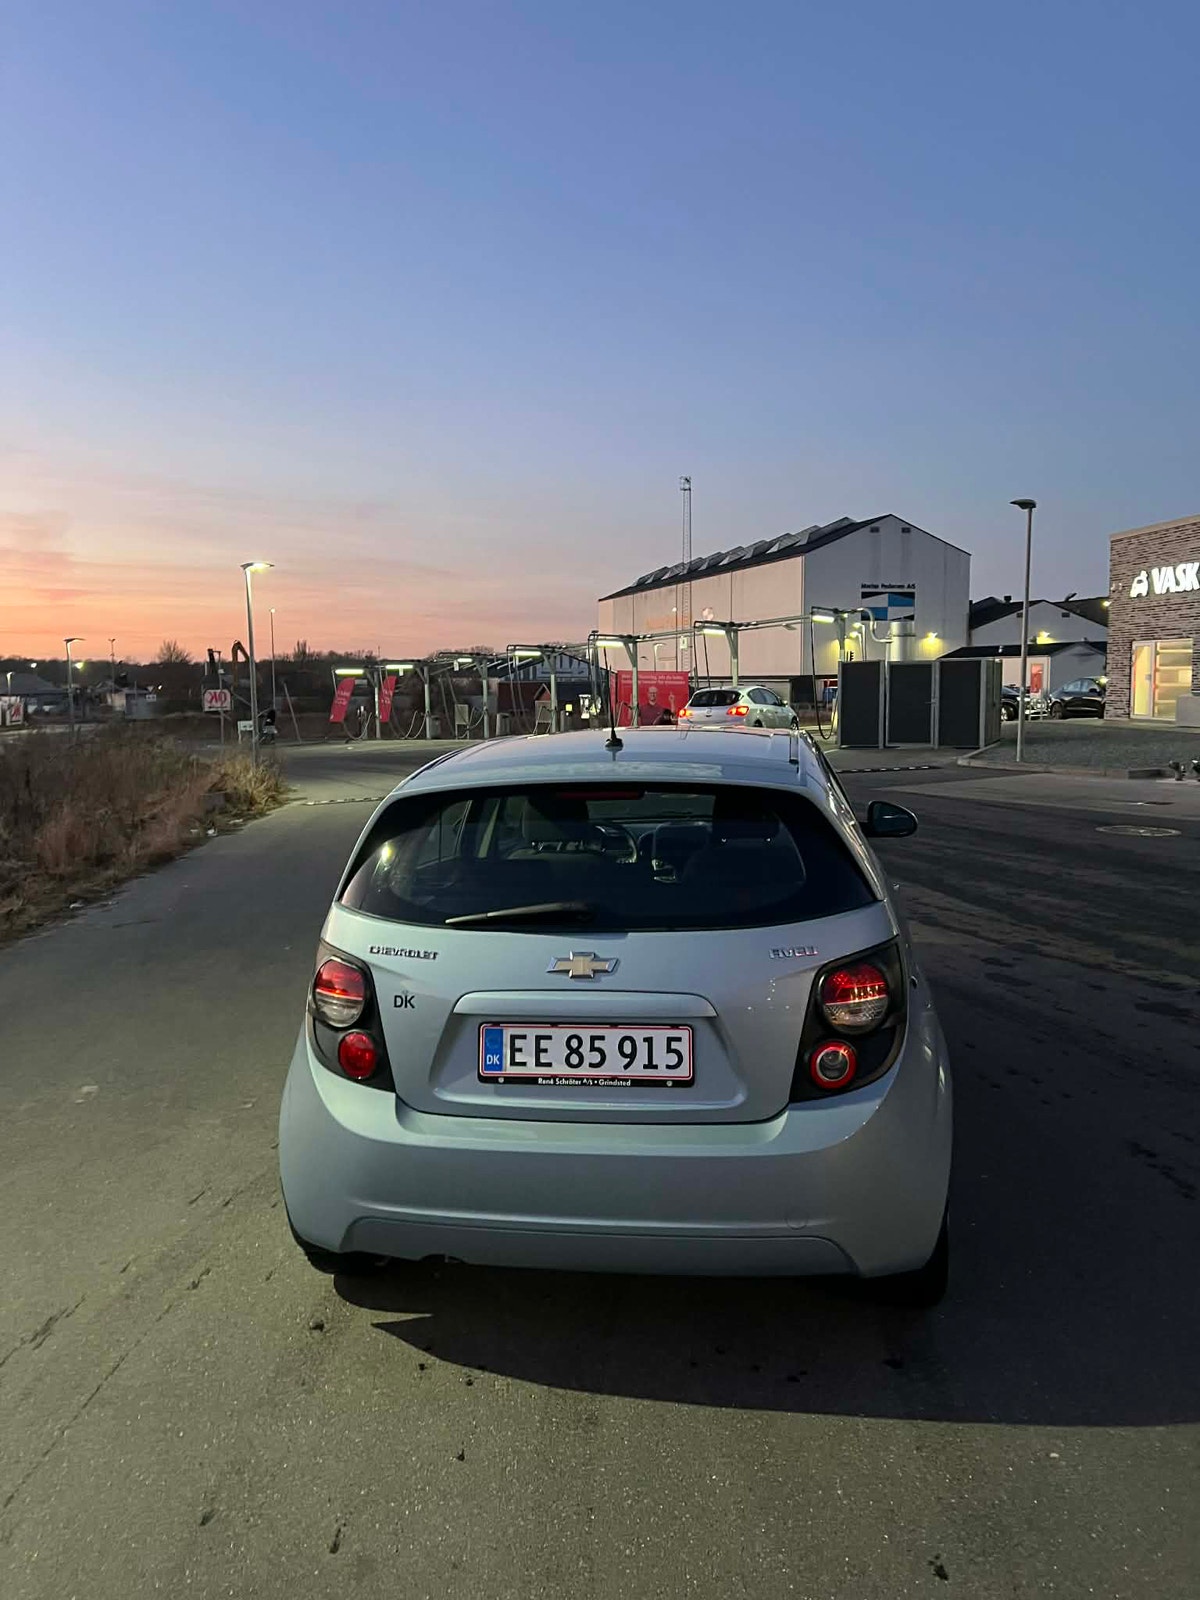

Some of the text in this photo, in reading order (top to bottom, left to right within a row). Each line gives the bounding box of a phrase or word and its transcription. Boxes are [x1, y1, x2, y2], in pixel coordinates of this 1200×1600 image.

[1151, 562, 1200, 594] VASK
[369, 946, 439, 960] CHEVROLET
[769, 946, 819, 959] AVEO
[394, 994, 415, 1009] DK
[486, 1054, 500, 1065] DK
[509, 1034, 684, 1071] EE 85 915
[538, 1077, 554, 1085] René
[598, 1079, 631, 1087] Grindsted
